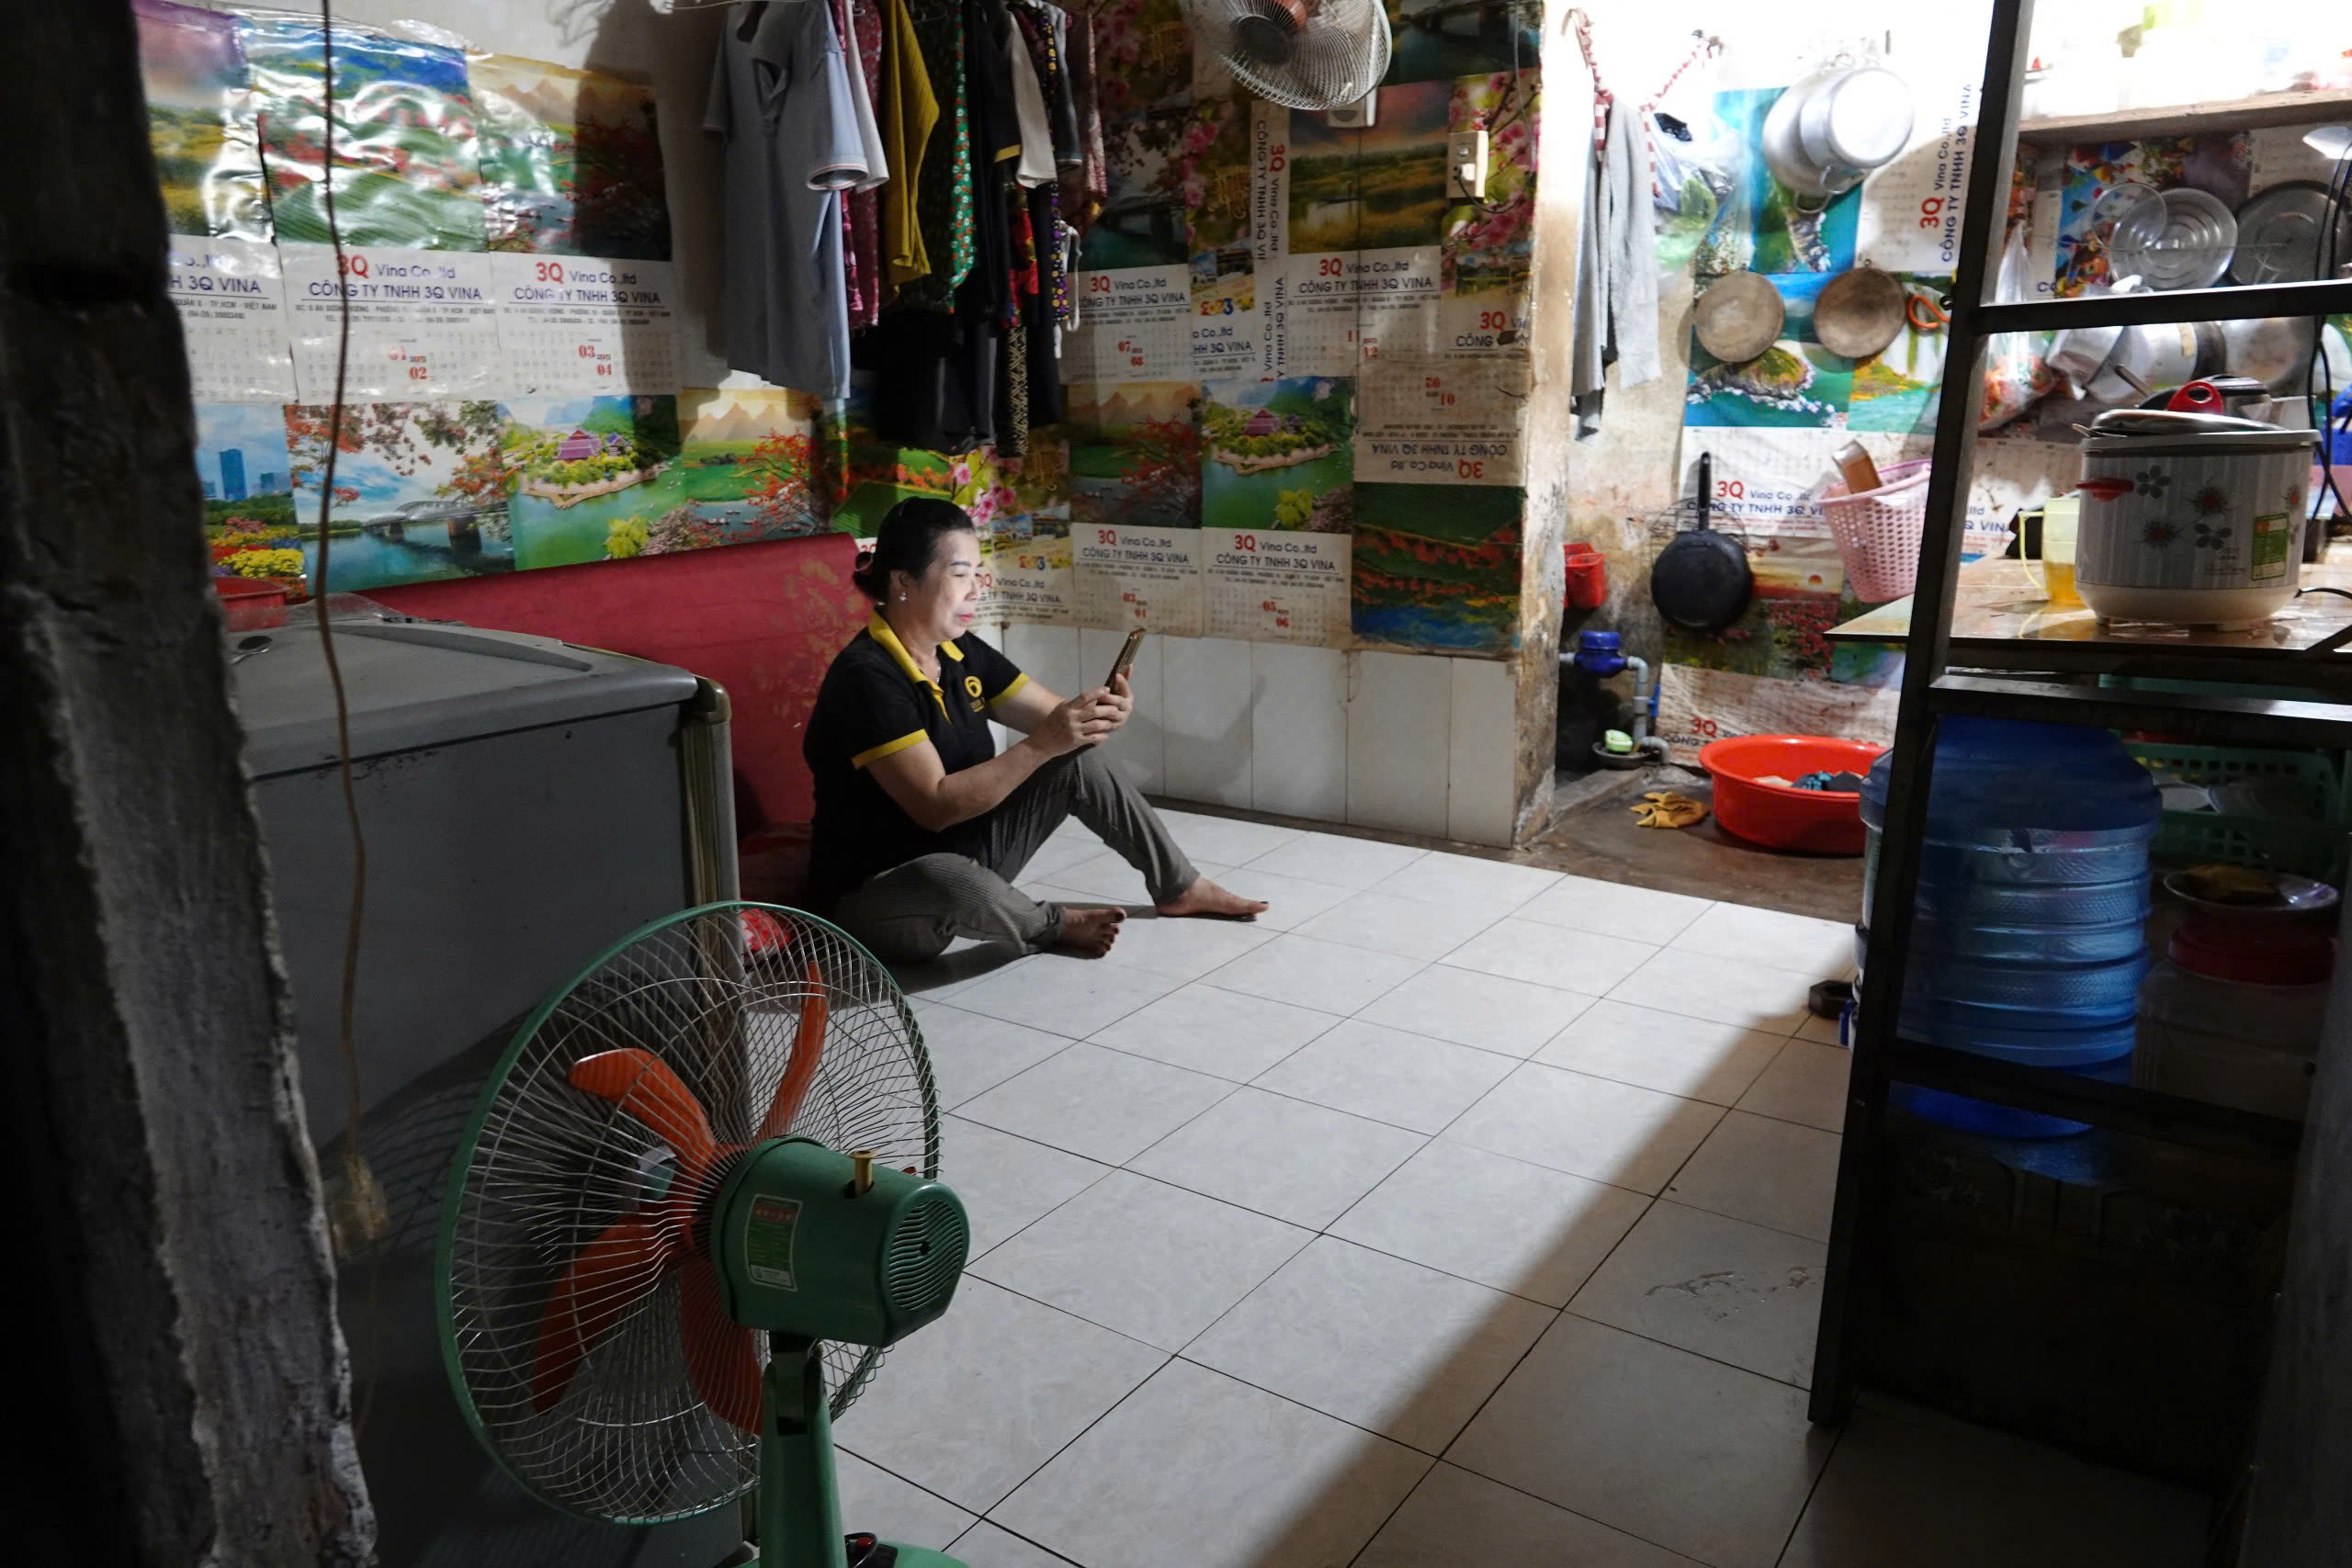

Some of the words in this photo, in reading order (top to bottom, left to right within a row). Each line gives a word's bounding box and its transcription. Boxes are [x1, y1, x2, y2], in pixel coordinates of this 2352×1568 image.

[1257, 119, 1269, 163] CÔNG
[1955, 125, 1969, 147] 3Q
[1270, 143, 1286, 172] 3Q
[1257, 165, 1267, 180] TY
[1951, 149, 1965, 192] TNHH
[1257, 185, 1267, 218] TNHH
[1919, 197, 1945, 229] 3Q
[1934, 160, 1948, 192] Vina
[1948, 196, 1961, 214] TY
[1257, 221, 1267, 240] 3Q
[1939, 216, 1958, 263] CÔNG
[337, 254, 369, 279] 3Q
[375, 264, 407, 277] Vina
[535, 261, 565, 284] 3Q
[569, 271, 596, 283] Vina
[1318, 257, 1342, 277] 3Q
[188, 276, 213, 291] 3Q
[217, 277, 263, 293] VINA
[309, 279, 358, 298] CÔNG
[362, 284, 379, 298] TY
[383, 285, 421, 299] TNHH
[424, 286, 445, 299] 3Q
[447, 286, 482, 300] VINA
[1090, 275, 1111, 293] 3Q
[1275, 276, 1285, 309] VINA
[1299, 278, 1332, 294] CÔNG
[1335, 281, 1347, 291] TY
[1382, 277, 1398, 289] 3Q
[1403, 276, 1434, 288] VINA
[514, 286, 555, 300] CÔNG
[576, 289, 608, 302] TNHH
[611, 291, 628, 303] 3Q
[631, 291, 661, 304] VINA
[1080, 296, 1103, 308] ÔNG
[1145, 293, 1159, 304] 3Q
[1161, 292, 1186, 302] VINA
[1275, 311, 1285, 330] 3Q
[1479, 310, 1507, 332] 3Q
[1211, 343, 1225, 353] 3Q
[1227, 341, 1252, 352] VINA
[1455, 333, 1494, 346] CÔNG
[578, 344, 595, 358] 03
[1276, 334, 1285, 367] TNHH
[409, 366, 427, 379] 02
[1372, 444, 1399, 456] VINA
[1428, 461, 1454, 471] Vina
[1457, 459, 1486, 479] 3Q
[1716, 479, 1745, 500] 3Q
[1750, 490, 1772, 501] Vina
[1687, 502, 1726, 512] CNG
[1748, 503, 1782, 514] TNHH
[1787, 505, 1805, 515] 3Q
[1097, 529, 1116, 547] 3Q
[1234, 534, 1256, 553] 3Q
[1260, 542, 1283, 552] Vina
[1166, 553, 1190, 563] VINA
[1216, 552, 1248, 566] CÔNG
[1250, 556, 1261, 566] TY
[1265, 557, 1291, 568] TNHH
[1293, 558, 1308, 569] 3Q
[1310, 559, 1335, 570] VINA
[1690, 716, 1718, 739] 3Q
